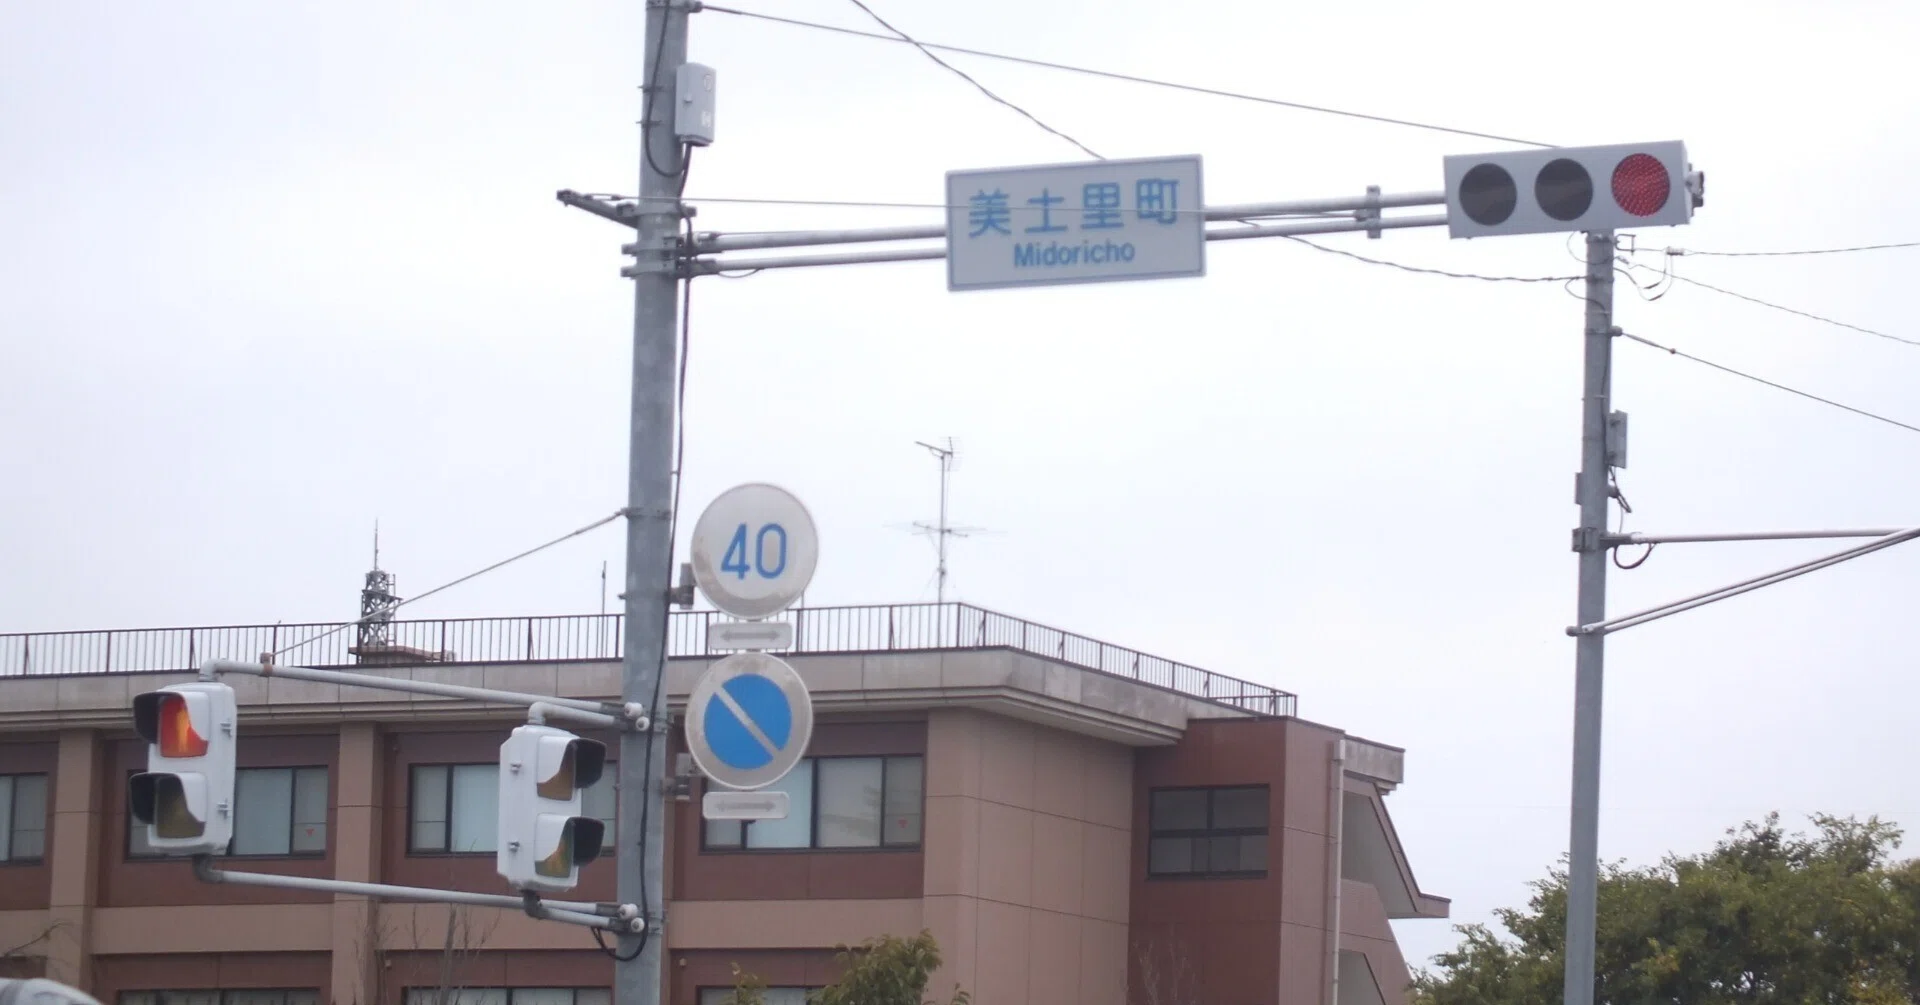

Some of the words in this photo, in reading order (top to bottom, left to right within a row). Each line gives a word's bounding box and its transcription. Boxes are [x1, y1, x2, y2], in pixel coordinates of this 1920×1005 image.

[968, 177, 1179, 238] 美土里町
[1014, 239, 1135, 268] Midoricho
[720, 522, 787, 580] 40
